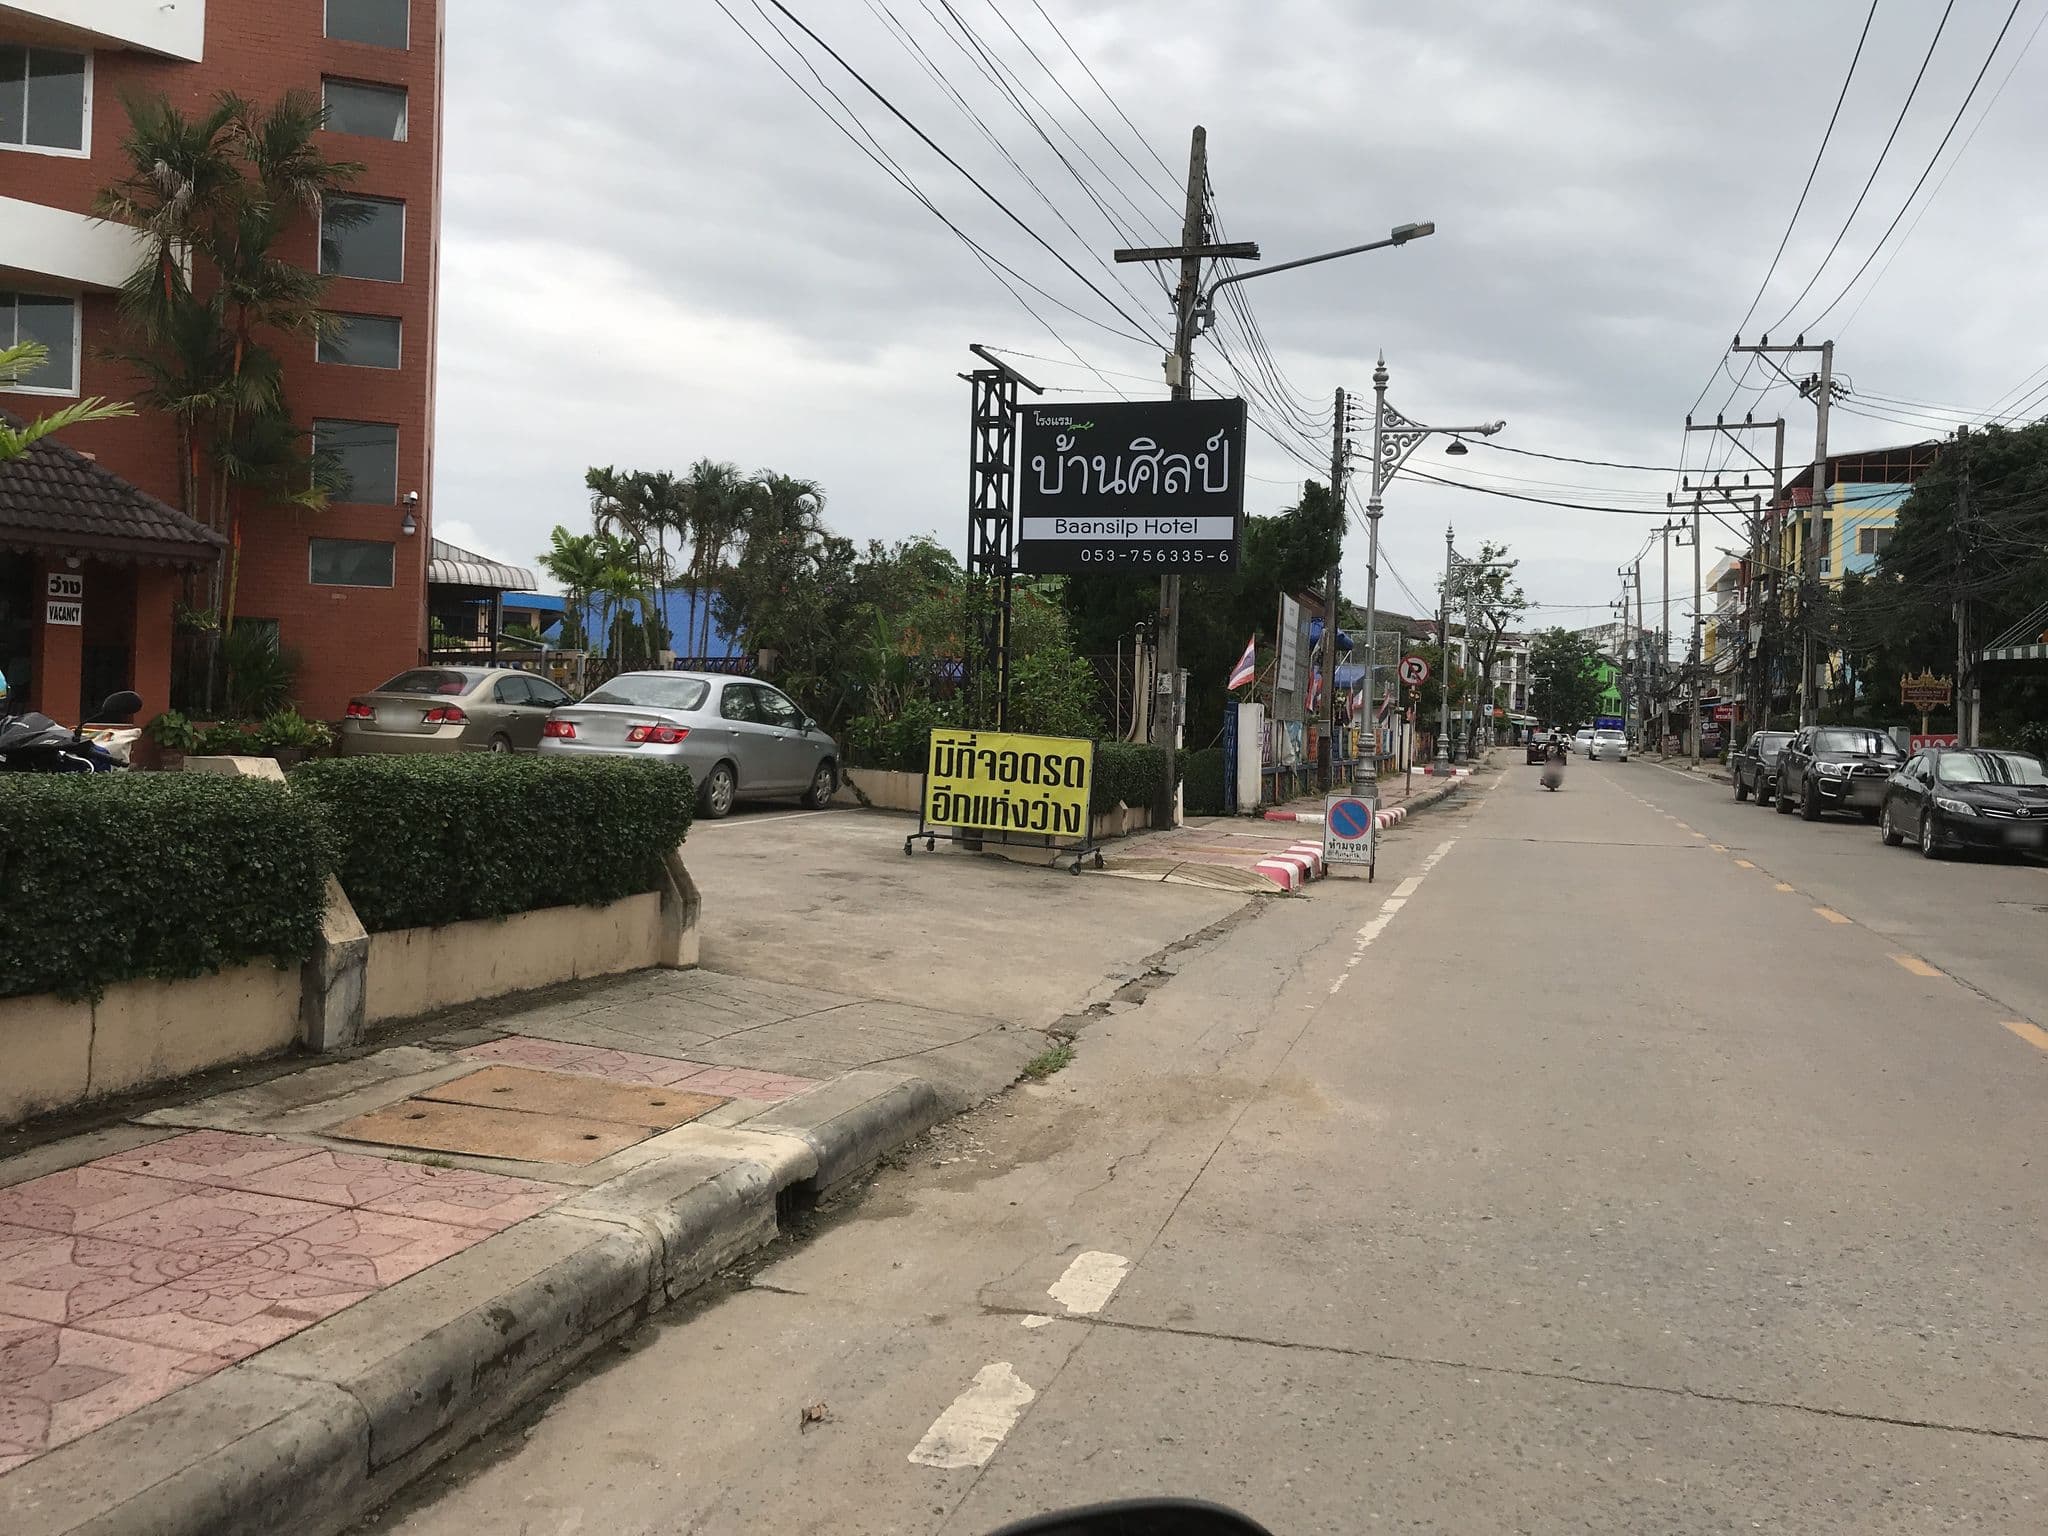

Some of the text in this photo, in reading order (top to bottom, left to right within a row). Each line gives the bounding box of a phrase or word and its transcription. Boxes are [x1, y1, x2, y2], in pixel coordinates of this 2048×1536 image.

[1033, 410, 1073, 426] โรงแรม
[1031, 428, 1229, 495] บ้านศิลป์
[1055, 518, 1198, 538] Baansilp Hotel
[1080, 549, 1229, 562] 053-756335-6
[49, 606, 80, 622] VACANCY
[931, 785, 1081, 833] อีกแห่งว่าง
